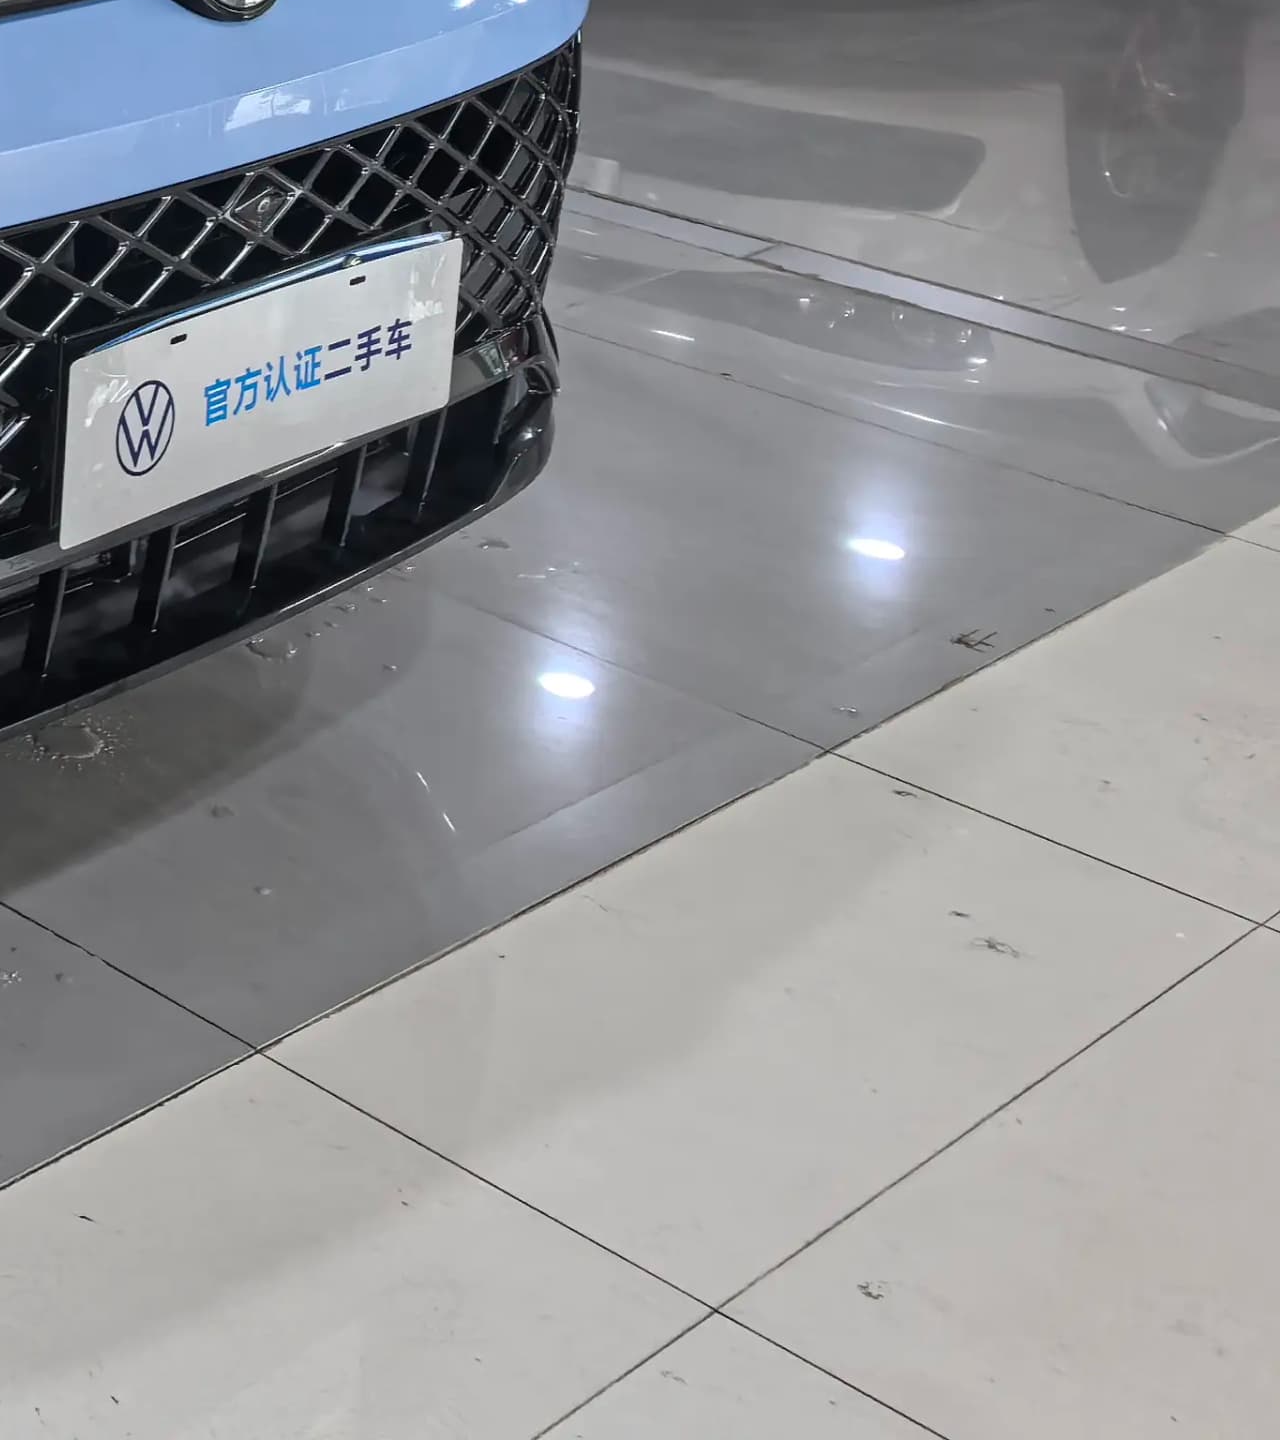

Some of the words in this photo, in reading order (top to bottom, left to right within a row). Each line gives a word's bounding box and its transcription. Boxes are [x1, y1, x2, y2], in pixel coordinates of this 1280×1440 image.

[204, 319, 413, 427] 官方认证二手车
